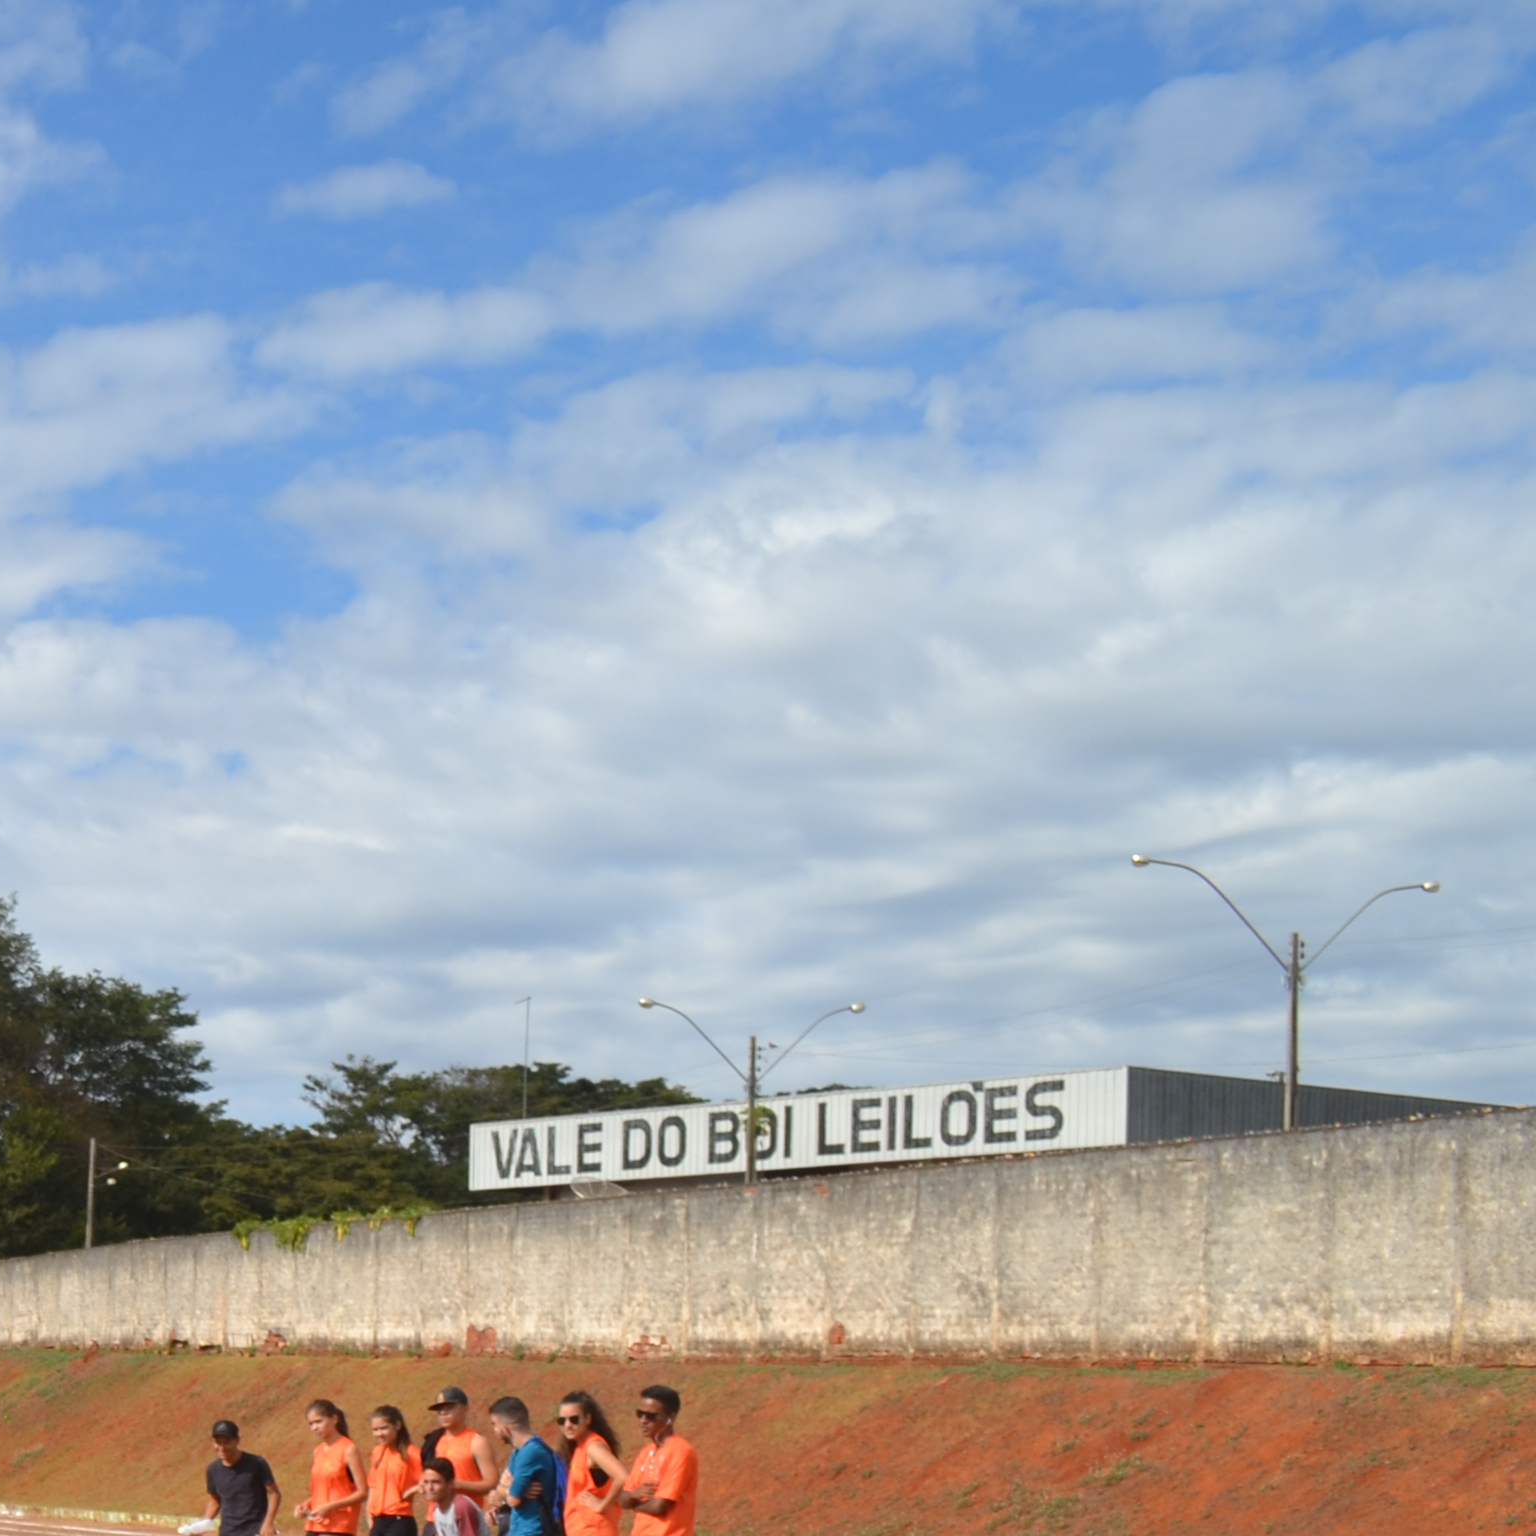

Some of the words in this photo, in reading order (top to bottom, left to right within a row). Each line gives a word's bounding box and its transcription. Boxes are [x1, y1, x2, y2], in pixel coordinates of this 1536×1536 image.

[490, 1122, 603, 1179] VALE
[622, 1115, 686, 1170] DO
[817, 1079, 1065, 1155] LEILÕES
